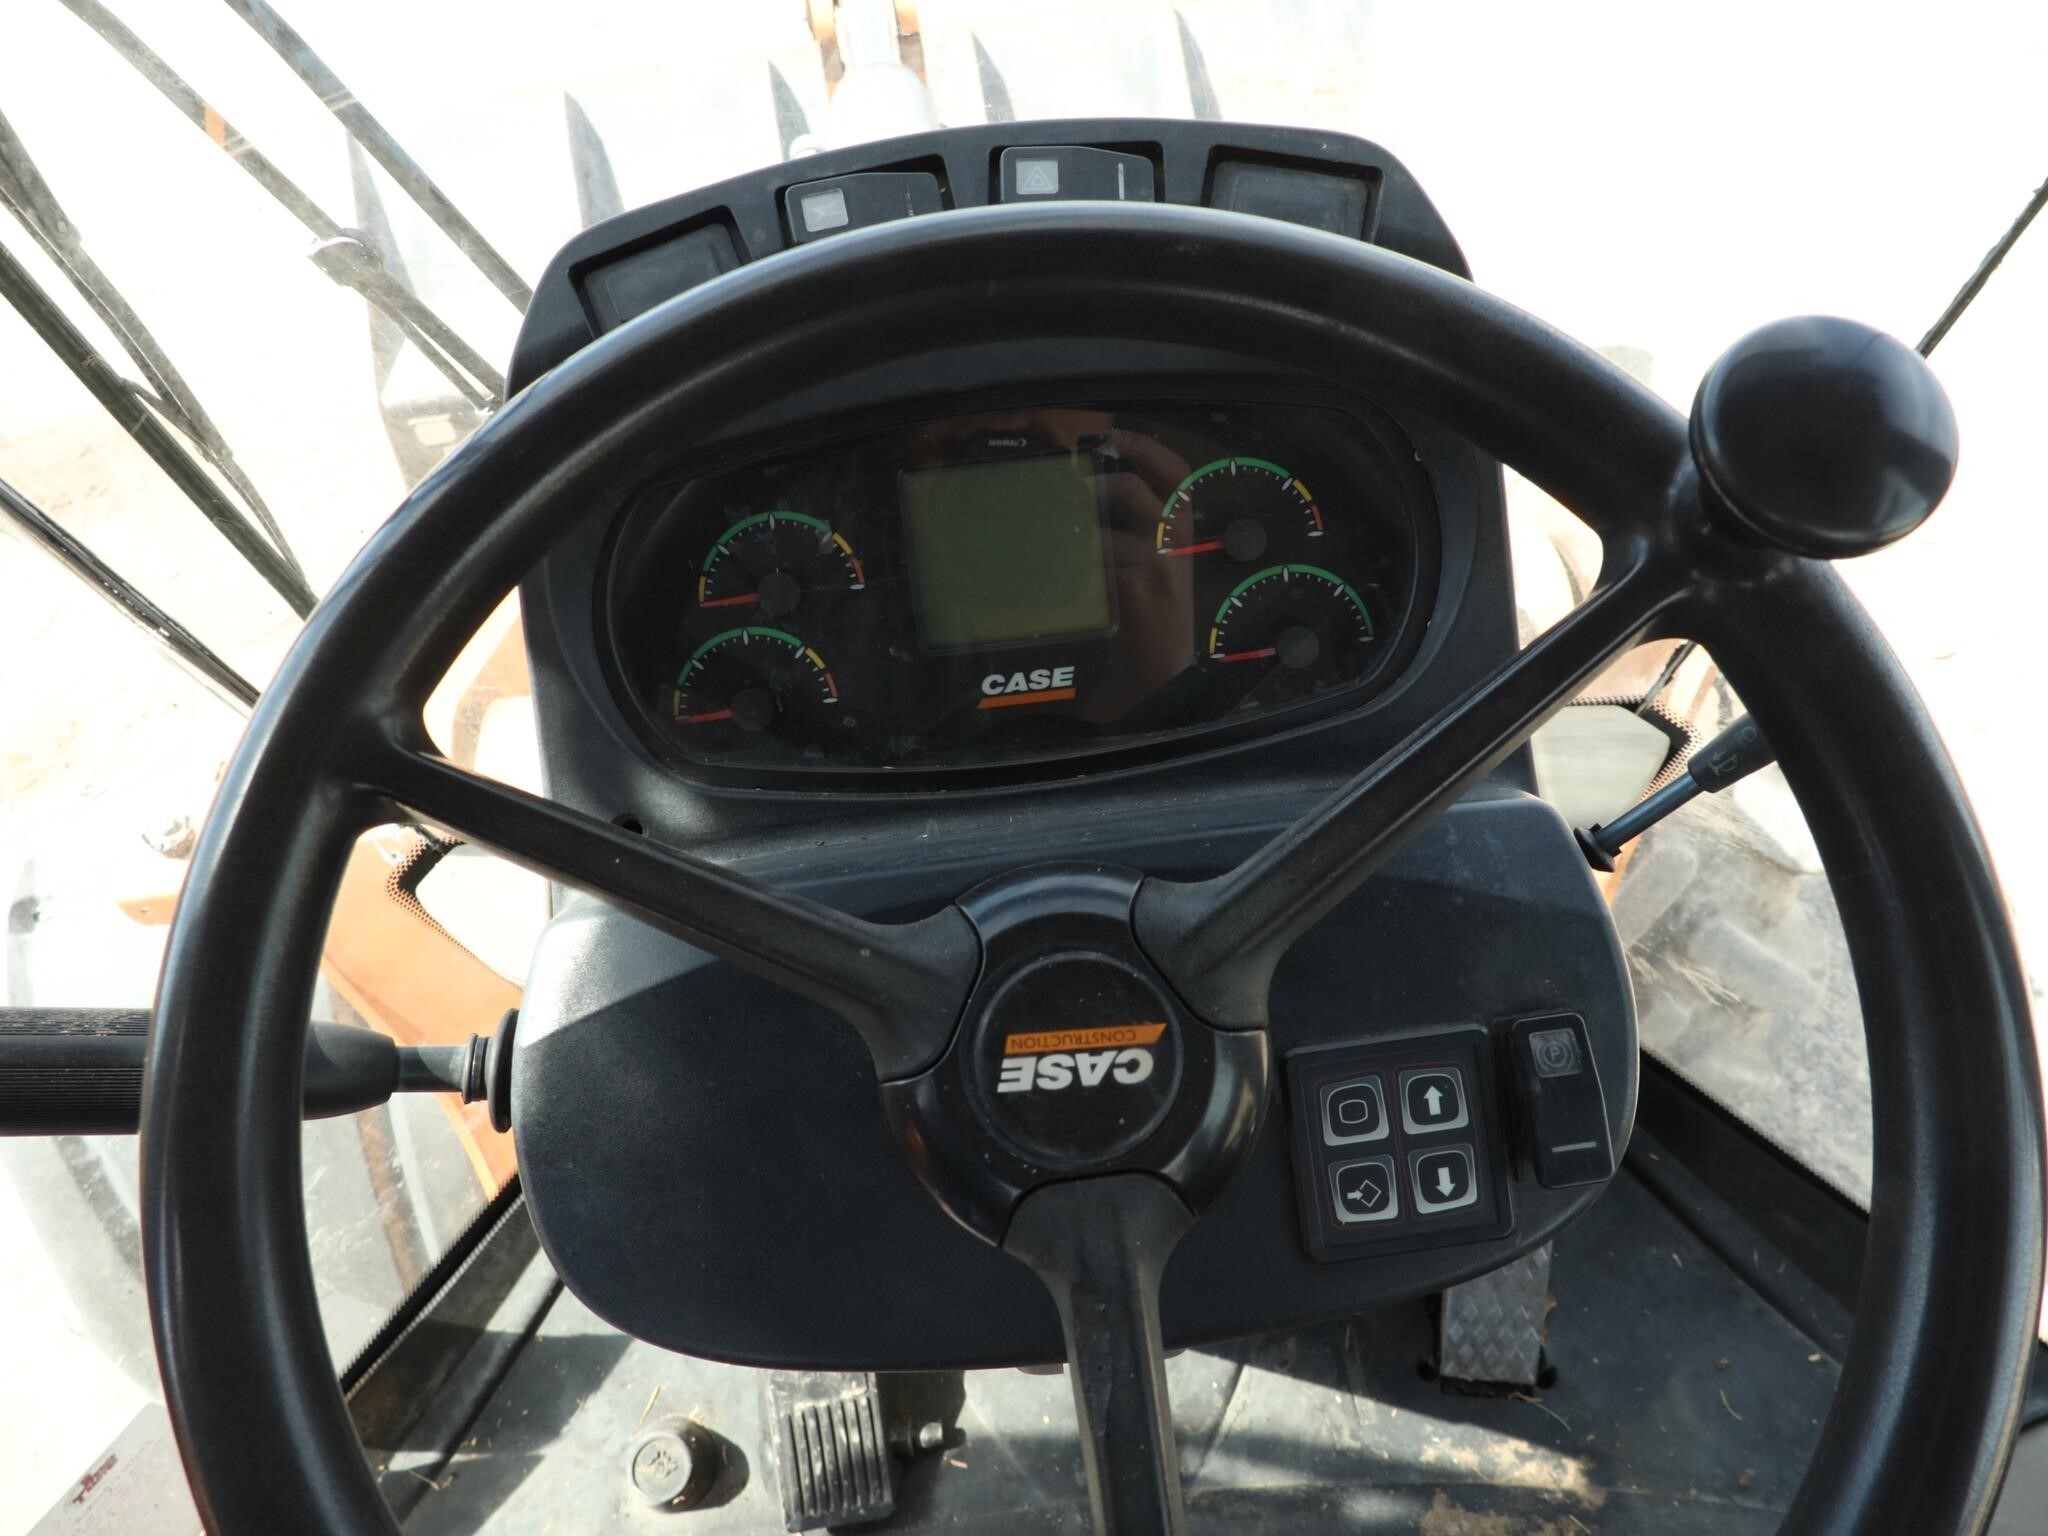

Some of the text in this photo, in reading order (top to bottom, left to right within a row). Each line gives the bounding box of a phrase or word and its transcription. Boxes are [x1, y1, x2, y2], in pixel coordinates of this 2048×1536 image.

[981, 666, 1075, 696] CASE
[1010, 1029, 1137, 1049] CONSTRUCTION
[997, 1048, 1154, 1093] CASE
